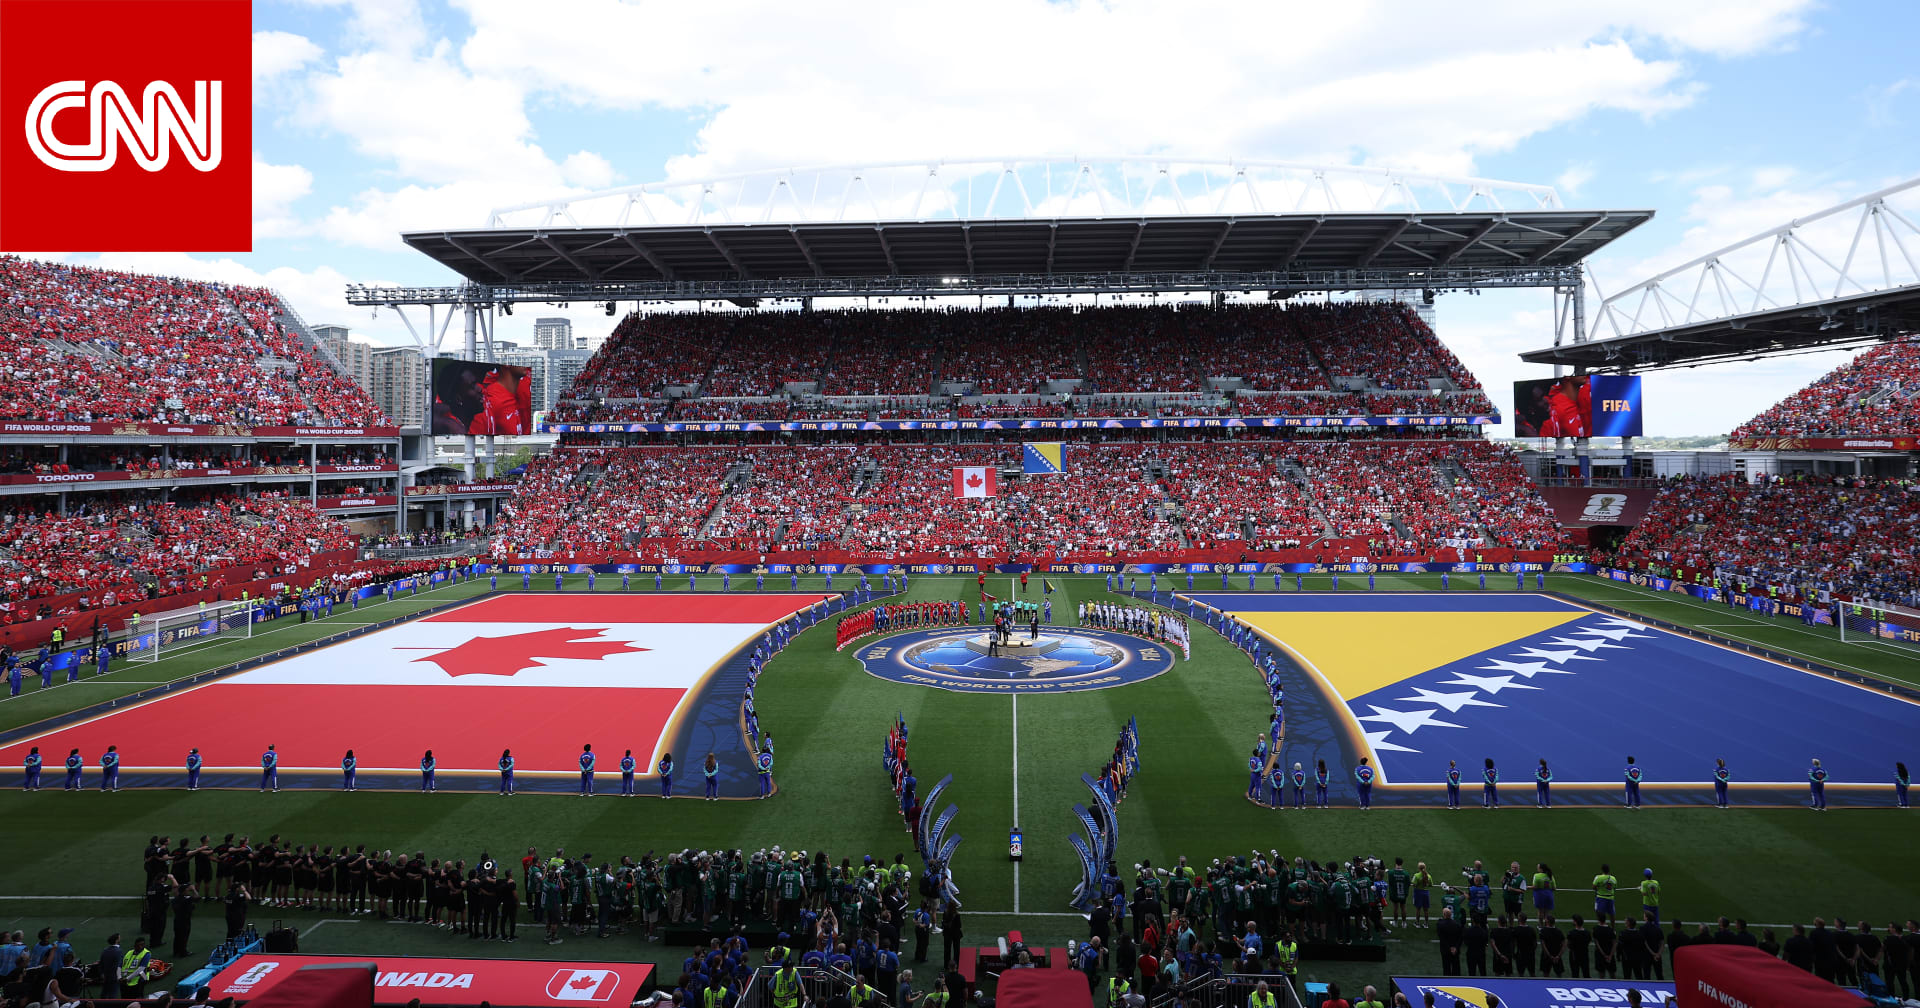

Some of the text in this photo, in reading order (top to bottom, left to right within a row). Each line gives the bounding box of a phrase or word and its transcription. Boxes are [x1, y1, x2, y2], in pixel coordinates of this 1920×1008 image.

[1602, 399, 1631, 412] FIFA
[36, 473, 95, 482] TORONTO
[1613, 571, 1627, 580] FIFA
[270, 582, 284, 590] FIFA
[280, 604, 298, 616] FIFA
[178, 626, 200, 638] FIFA
[116, 638, 140, 654] FIFA
[867, 646, 892, 660] FIFA
[902, 674, 938, 684] FIFA
[942, 680, 1006, 690] WORLD
[1058, 676, 1121, 688] 2026
[375, 972, 474, 988] NADA
[1698, 980, 1718, 1001] FIFA
